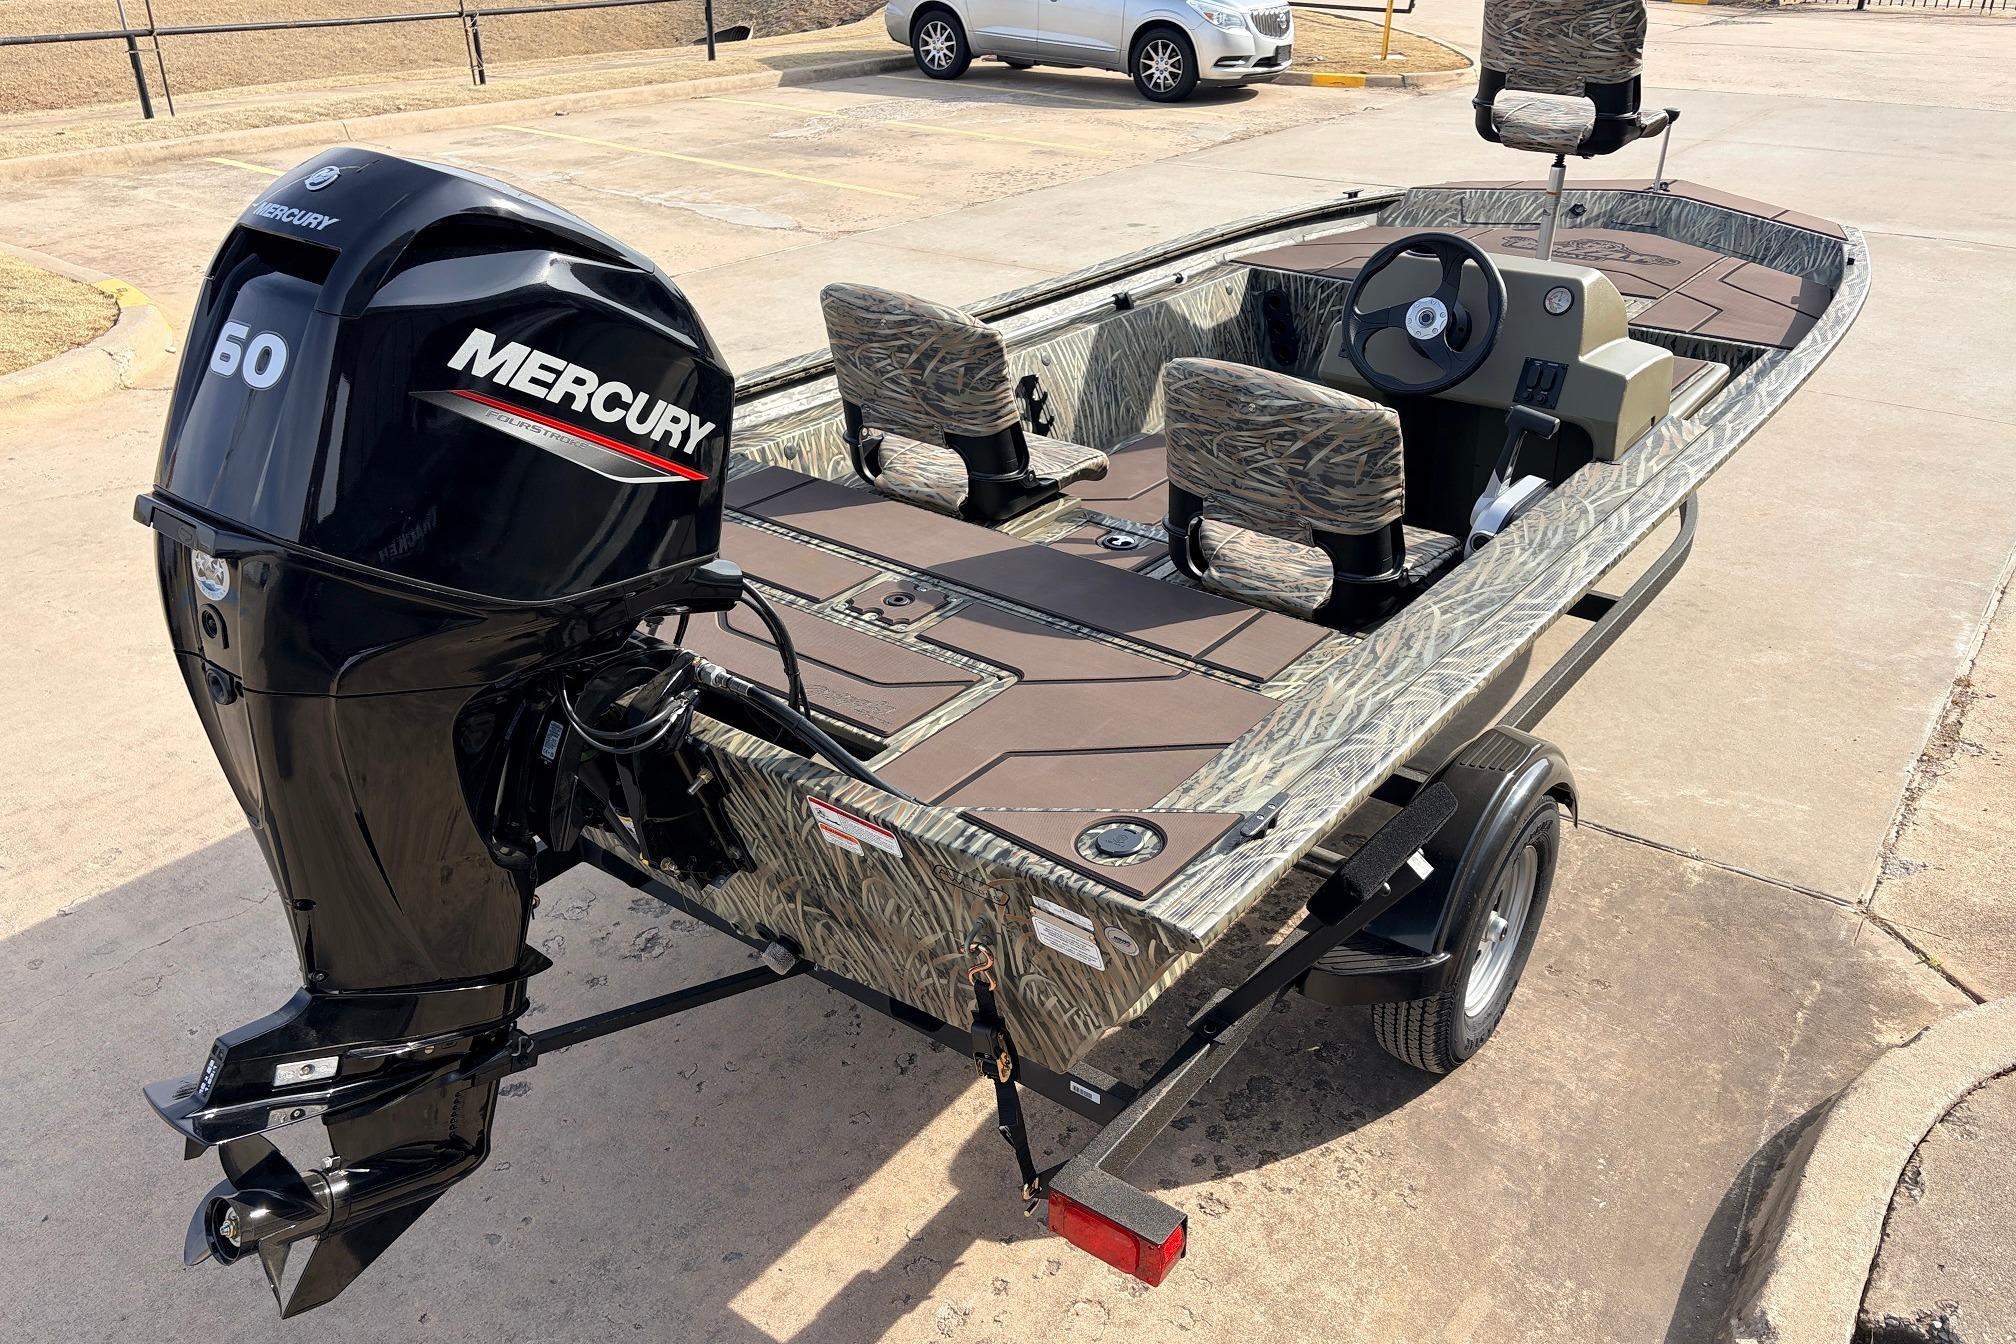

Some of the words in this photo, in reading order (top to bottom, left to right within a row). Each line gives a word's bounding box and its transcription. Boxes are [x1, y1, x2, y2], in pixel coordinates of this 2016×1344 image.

[252, 202, 340, 230] MERCURY
[210, 321, 288, 389] 60
[447, 328, 716, 454] MERCURY
[485, 408, 588, 449] FOURSTROKE
